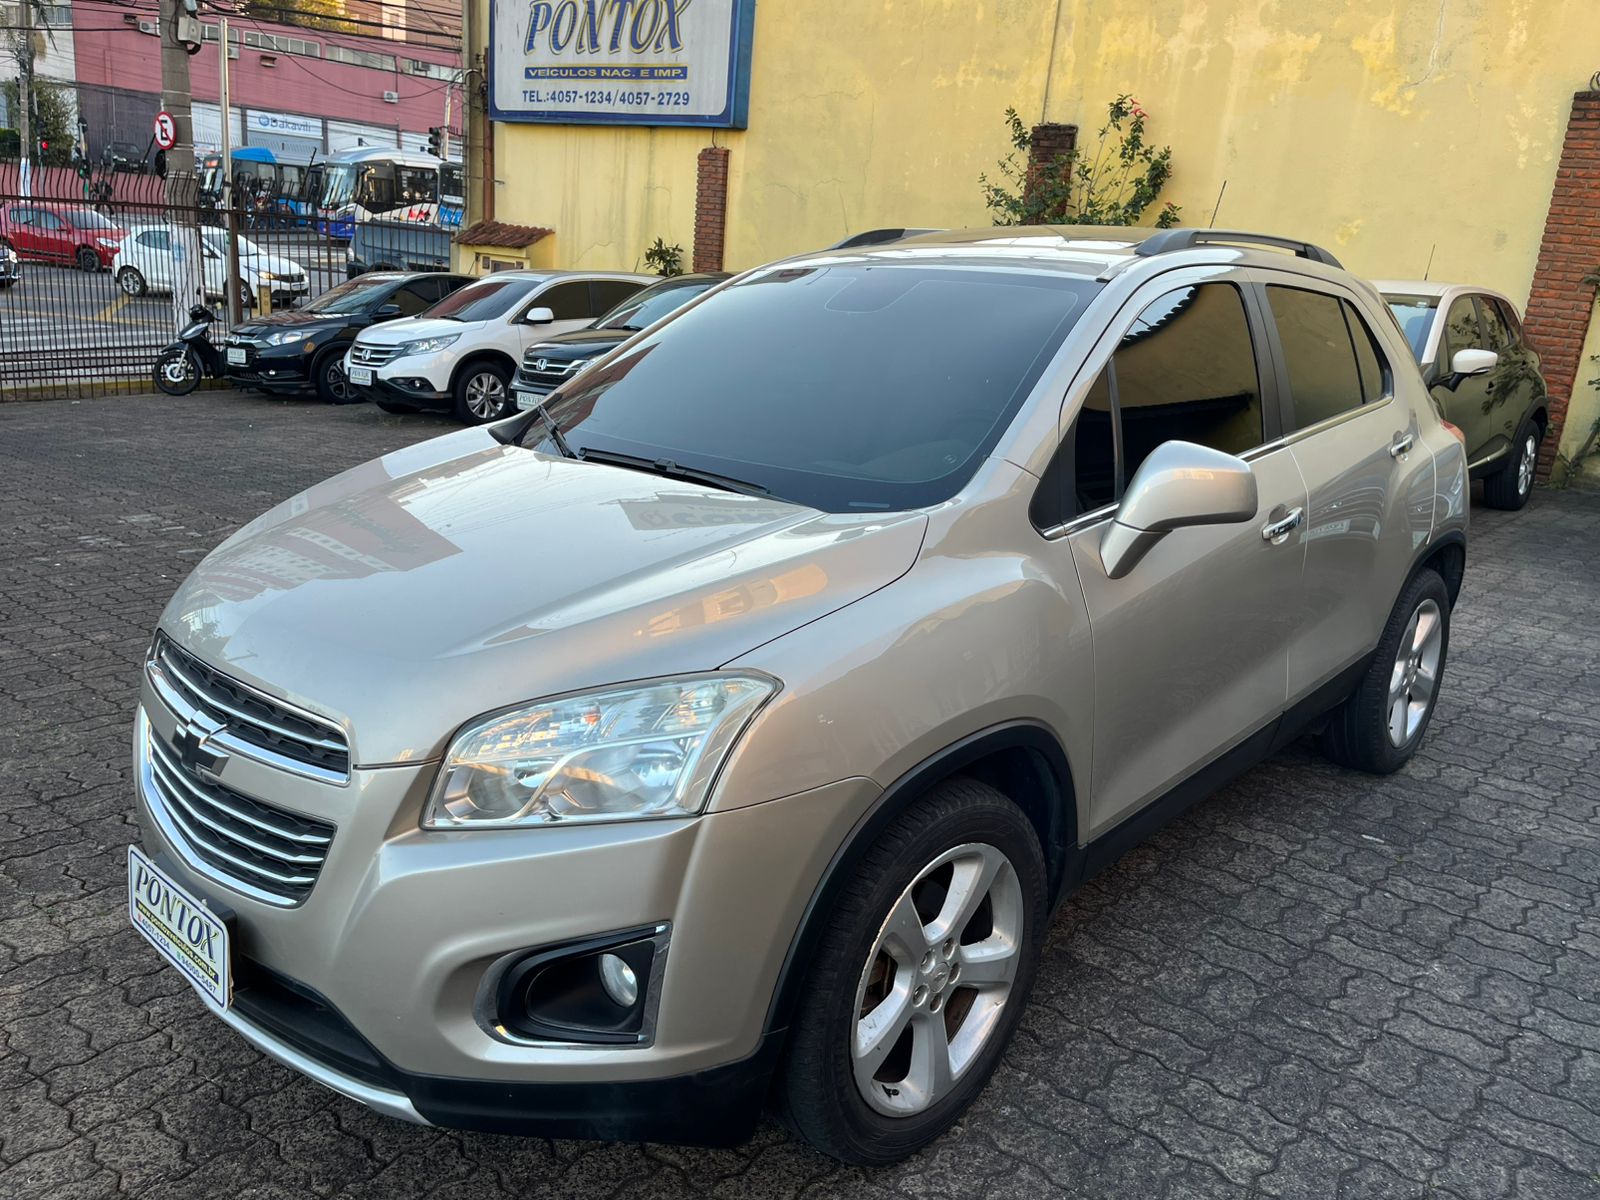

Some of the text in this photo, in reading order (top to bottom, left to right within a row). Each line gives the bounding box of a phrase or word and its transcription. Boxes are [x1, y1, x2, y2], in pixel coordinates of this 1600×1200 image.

[524, 0, 692, 55] PONTOX
[601, 69, 635, 77] NAC.
[640, 69, 650, 77] E
[654, 69, 684, 77] IMP.
[135, 863, 219, 964] PONTOX
